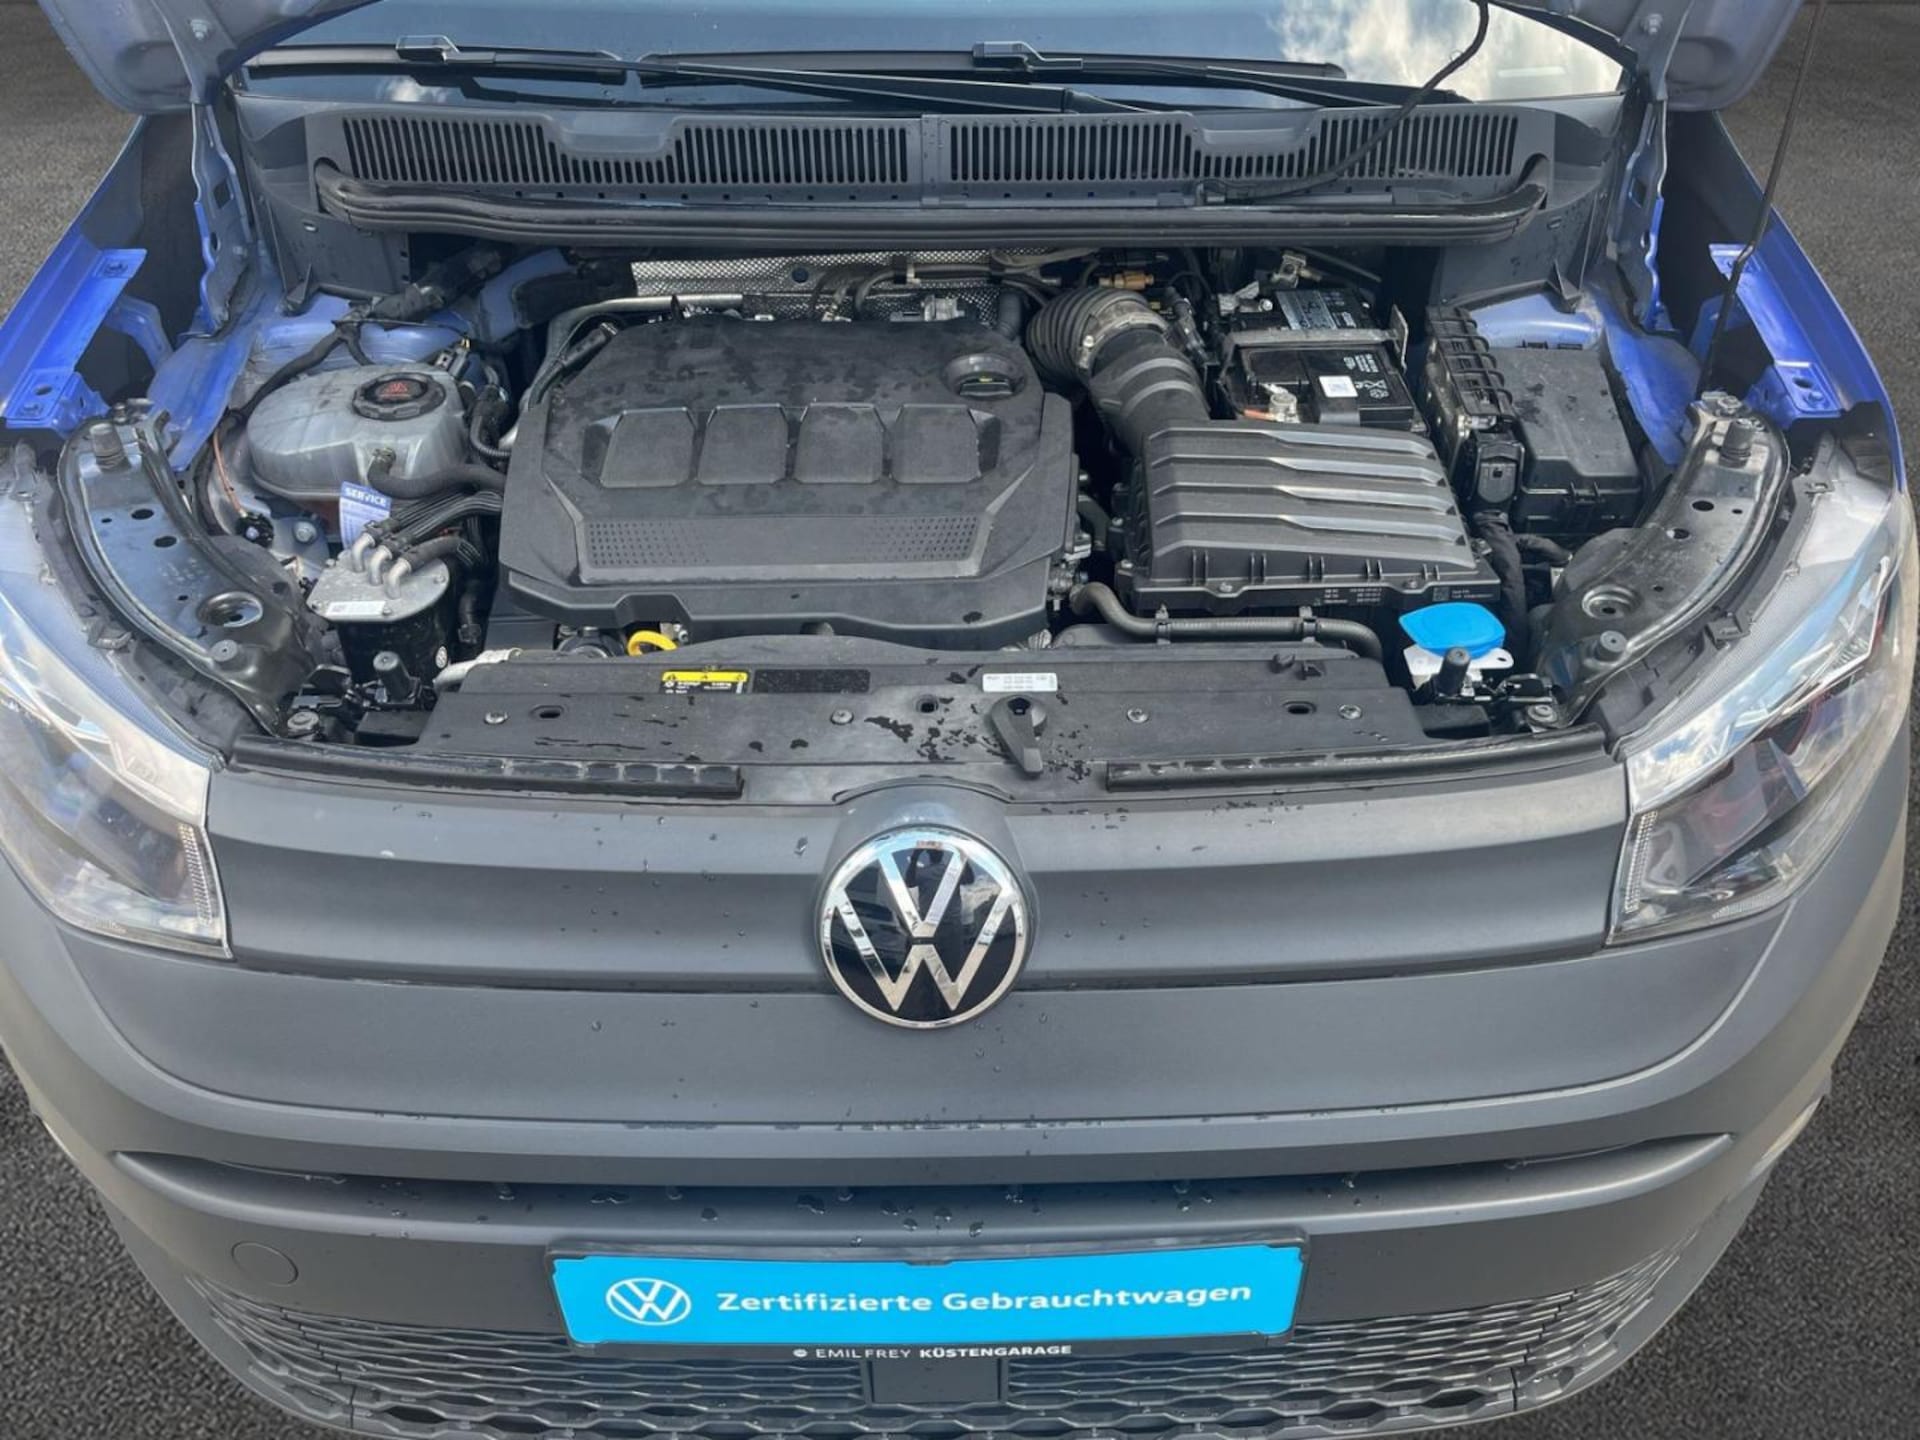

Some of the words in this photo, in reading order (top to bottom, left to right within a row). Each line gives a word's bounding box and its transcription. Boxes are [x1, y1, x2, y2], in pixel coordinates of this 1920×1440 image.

[344, 487, 387, 508] SERVICE
[716, 1292, 932, 1311] Zertifizierte
[943, 1286, 1251, 1311] Gebrauchtwagen
[815, 1348, 862, 1359] EMIL
[864, 1347, 912, 1359] FREY
[920, 1345, 1072, 1359] KÜSTENGARAGE
